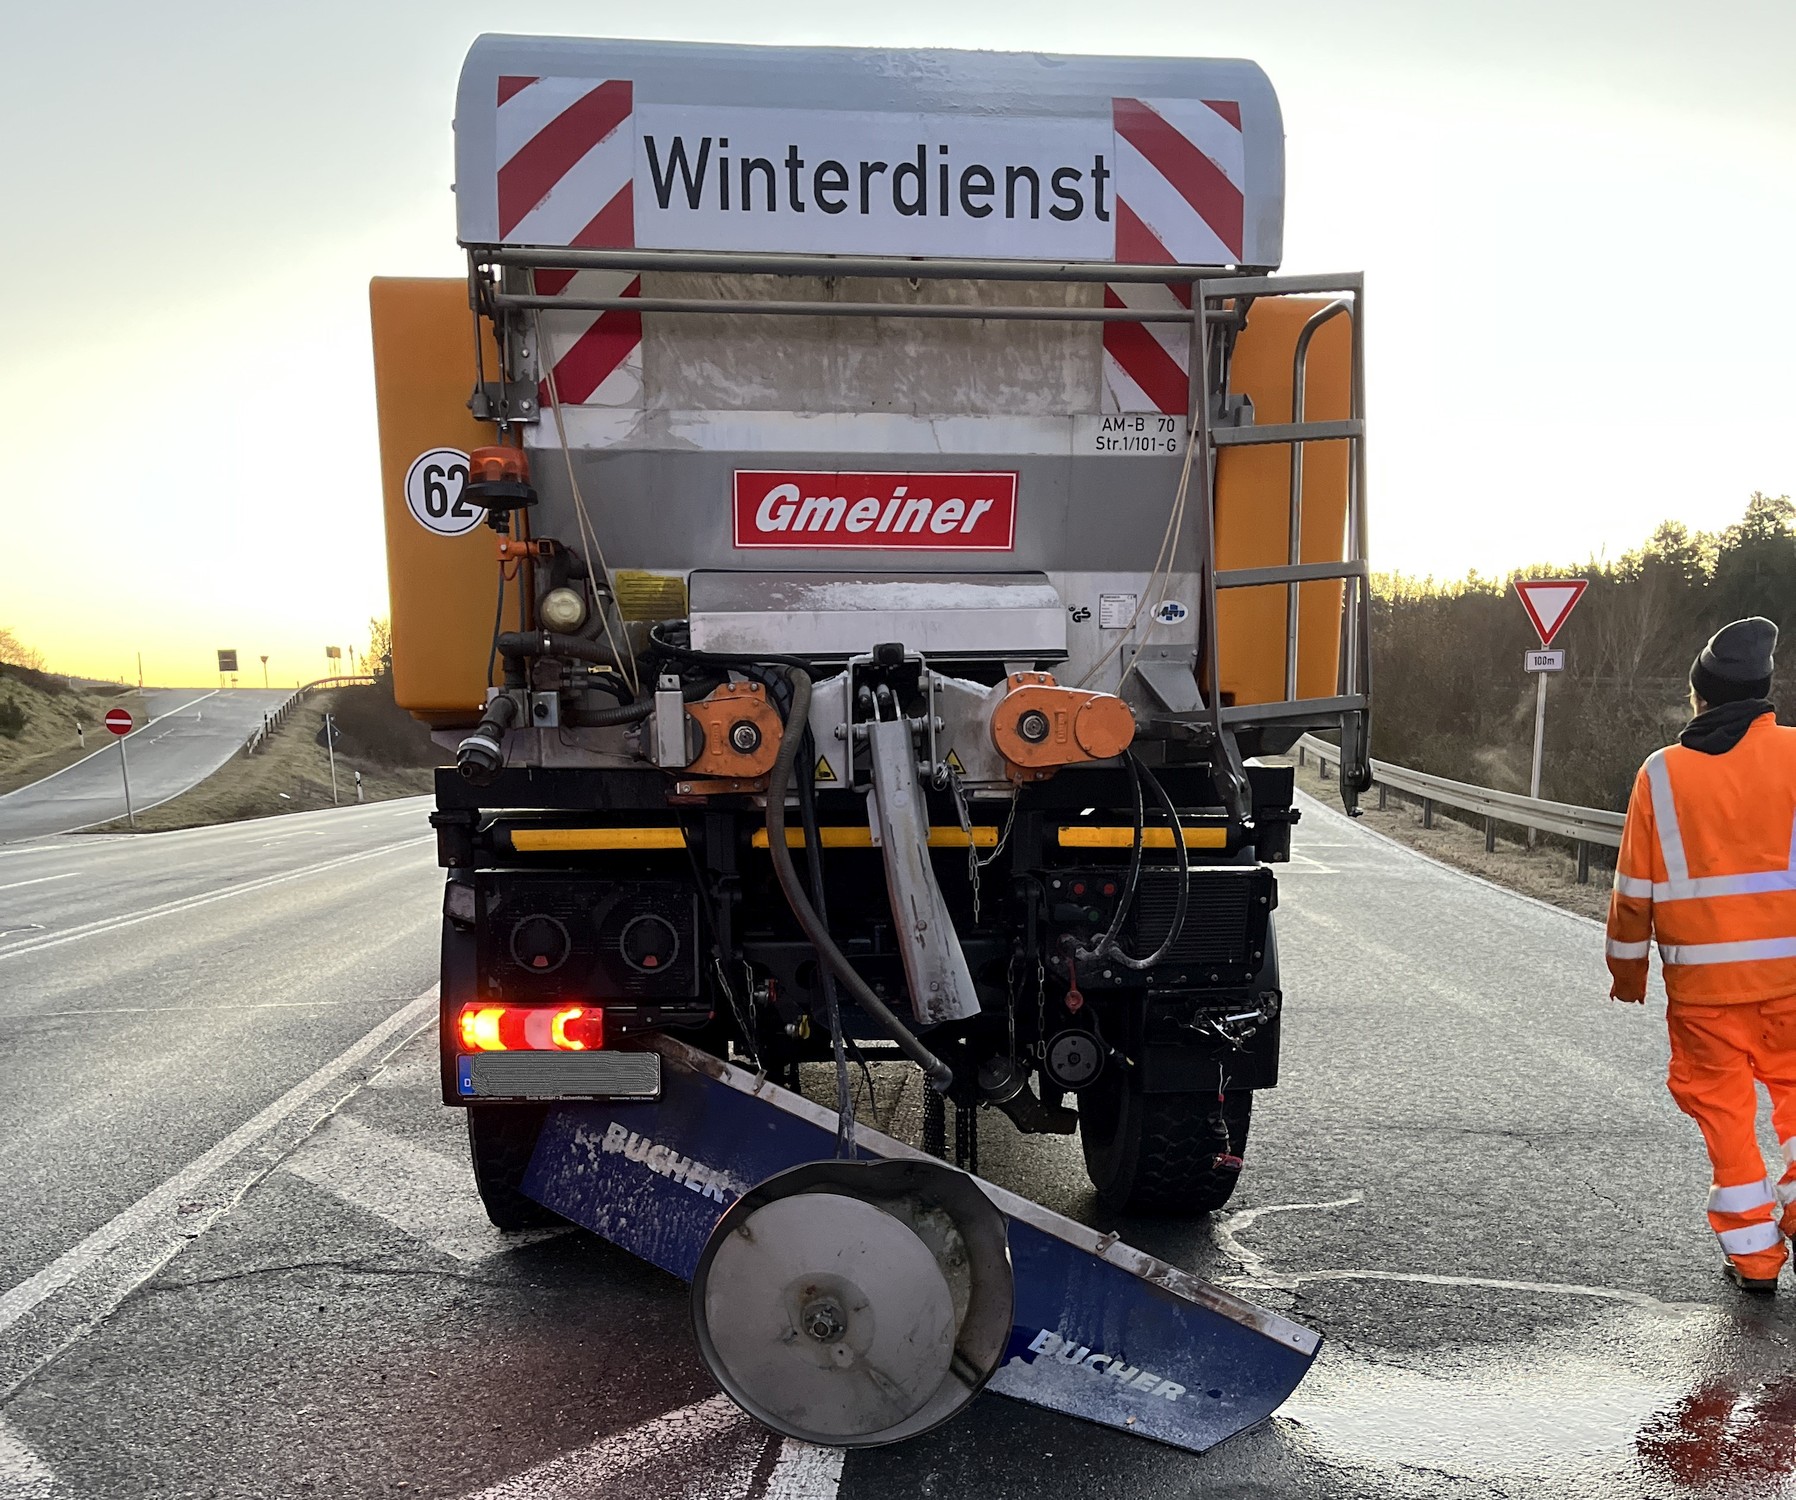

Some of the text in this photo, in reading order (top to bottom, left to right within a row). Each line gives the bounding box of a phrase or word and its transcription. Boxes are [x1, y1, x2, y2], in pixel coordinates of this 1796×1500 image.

[643, 134, 1111, 223] Winterdienst
[1096, 436, 1176, 452] Str.1/101-G
[1101, 417, 1175, 433] AM-B 70
[423, 463, 473, 518] 62
[755, 483, 994, 534] Gmeiner
[1534, 656, 1555, 666] 100m
[464, 1078, 471, 1088] D
[602, 1121, 726, 1205] BUCHER
[1027, 1328, 1187, 1402] BUCHER
